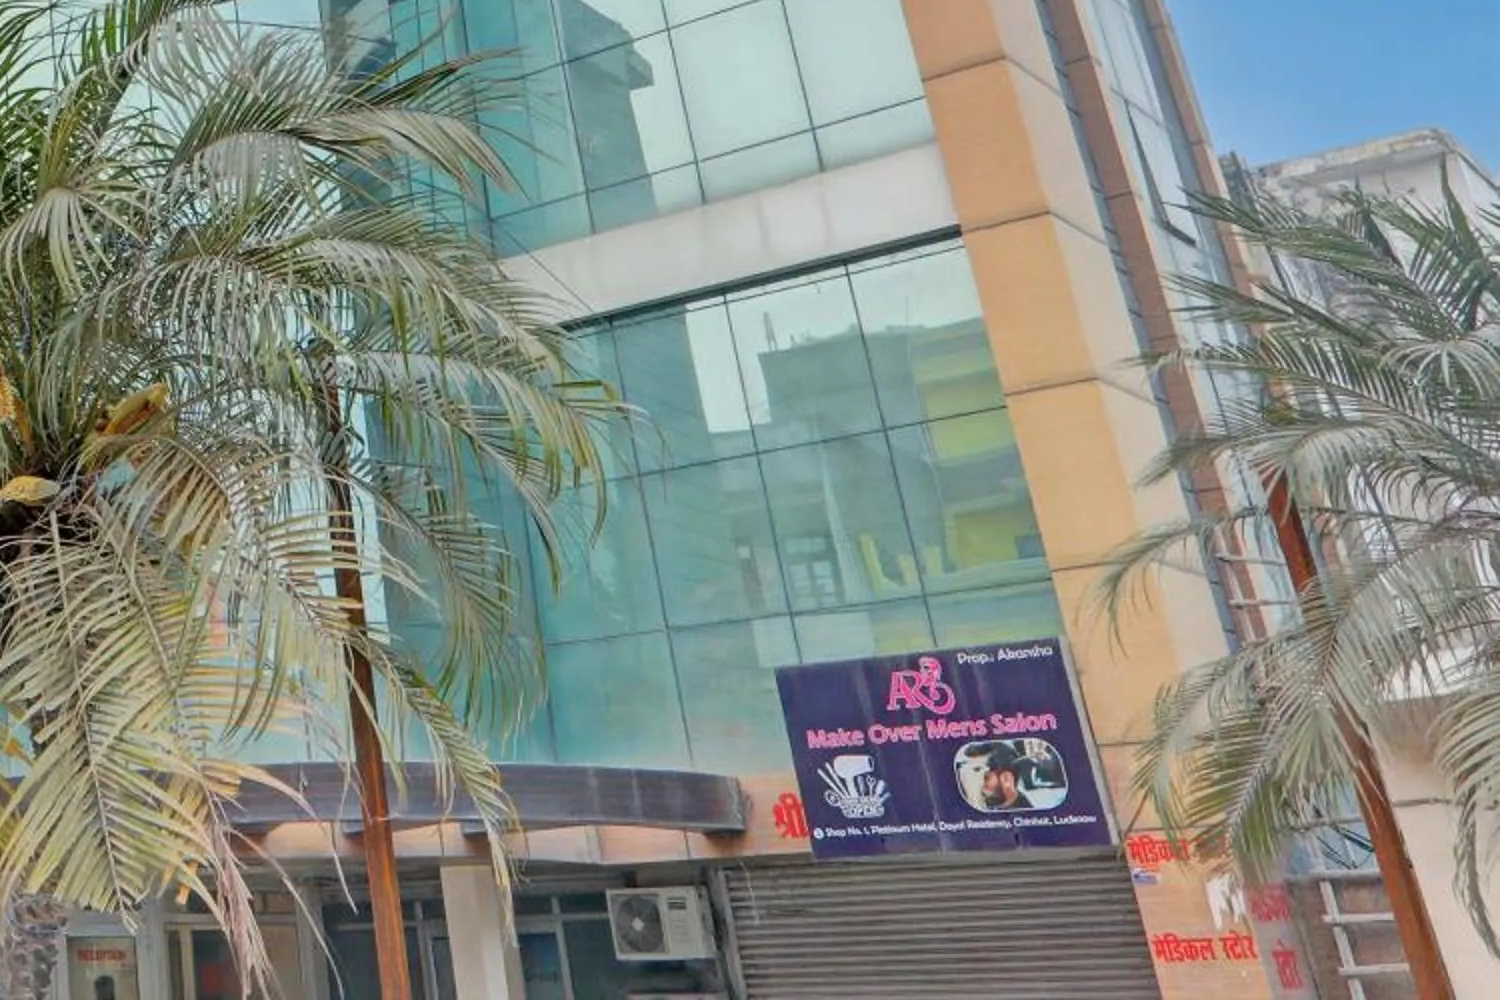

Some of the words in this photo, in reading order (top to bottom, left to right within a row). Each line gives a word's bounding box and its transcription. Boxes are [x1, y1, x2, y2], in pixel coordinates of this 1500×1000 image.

[807, 726, 865, 749] Make
[868, 720, 922, 745] Over
[926, 717, 986, 740] Mens
[991, 712, 1057, 735] Salon
[825, 827, 846, 837] Shop
[940, 820, 964, 832] Dayal
[1054, 815, 1097, 825] Lucknow
